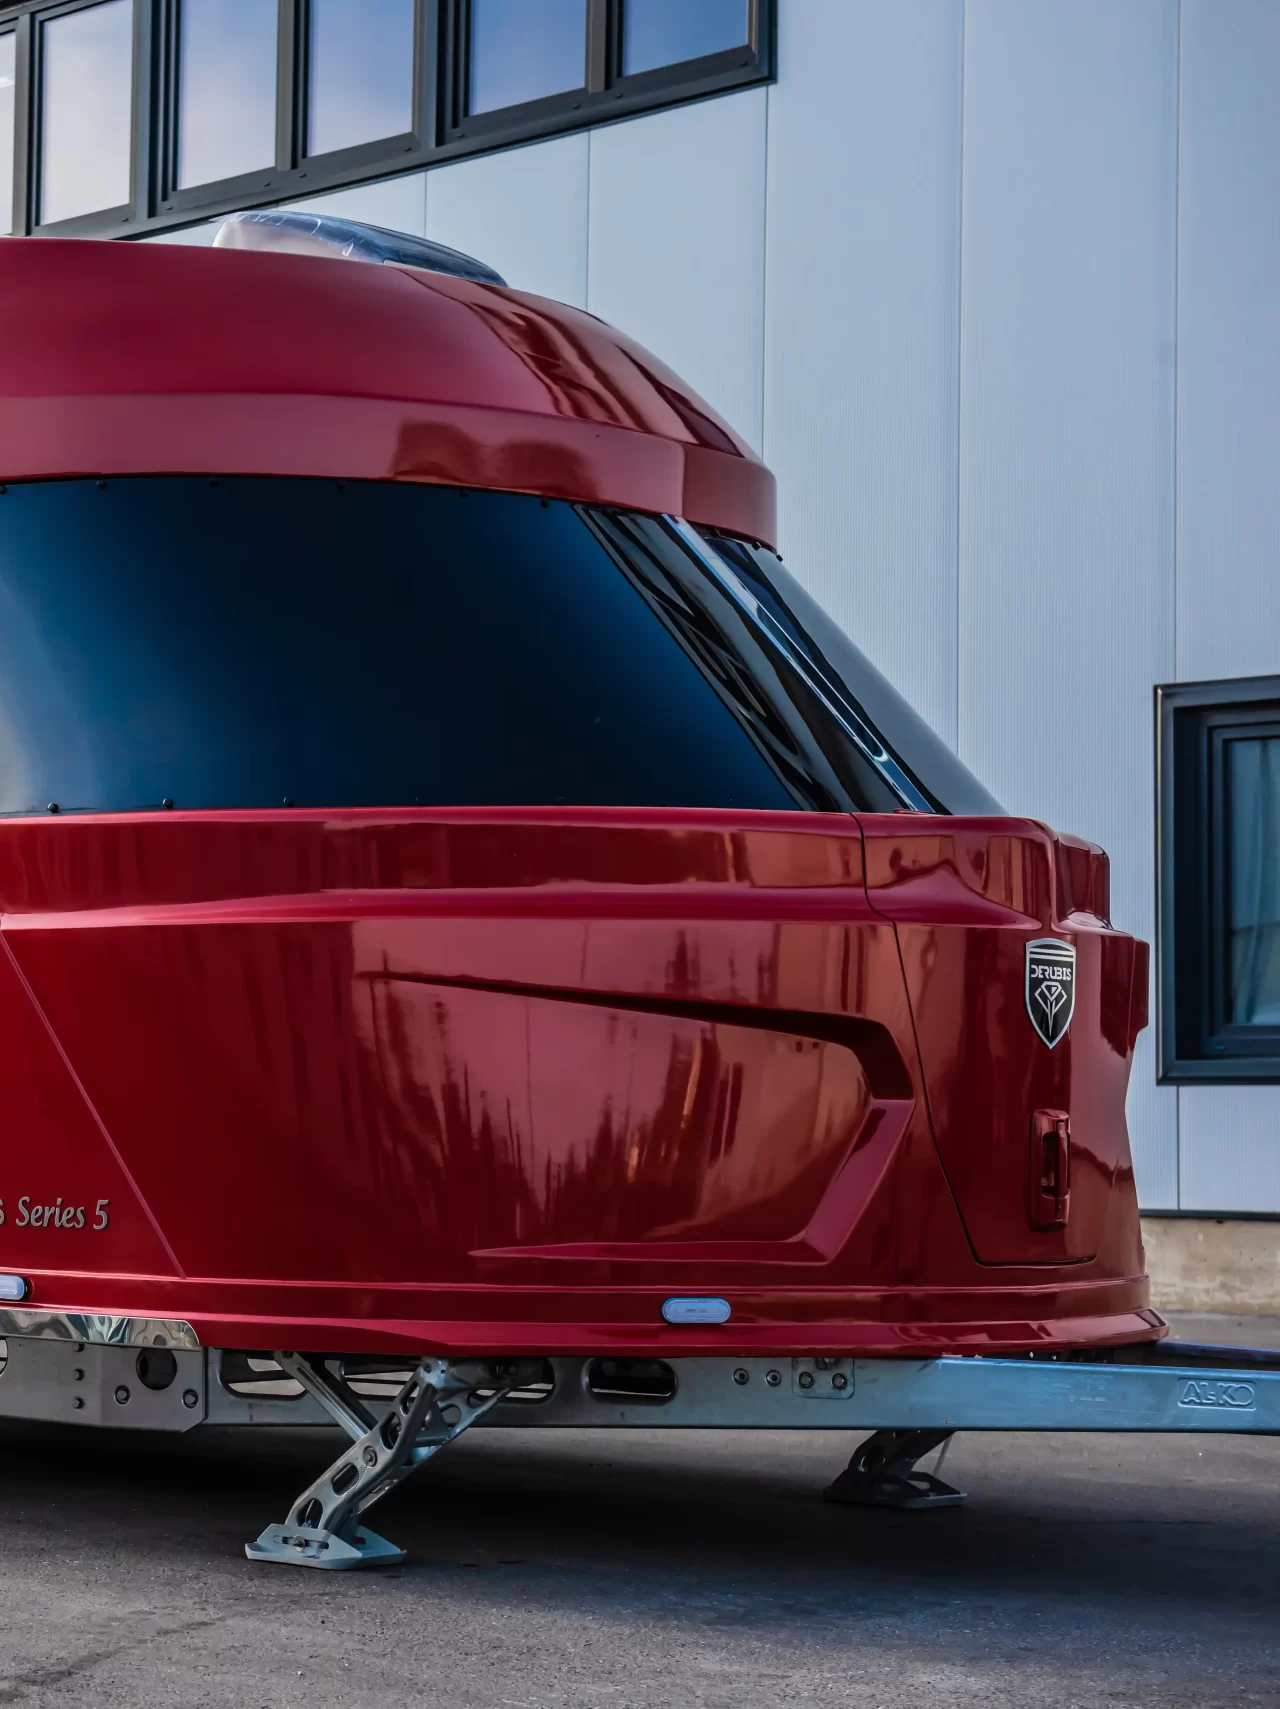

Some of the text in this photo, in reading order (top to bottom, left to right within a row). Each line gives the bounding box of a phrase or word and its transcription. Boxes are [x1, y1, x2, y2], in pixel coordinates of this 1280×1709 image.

[1030, 965, 1072, 981] DERUBIS
[15, 1196, 85, 1229] Series
[93, 1199, 110, 1230] 5
